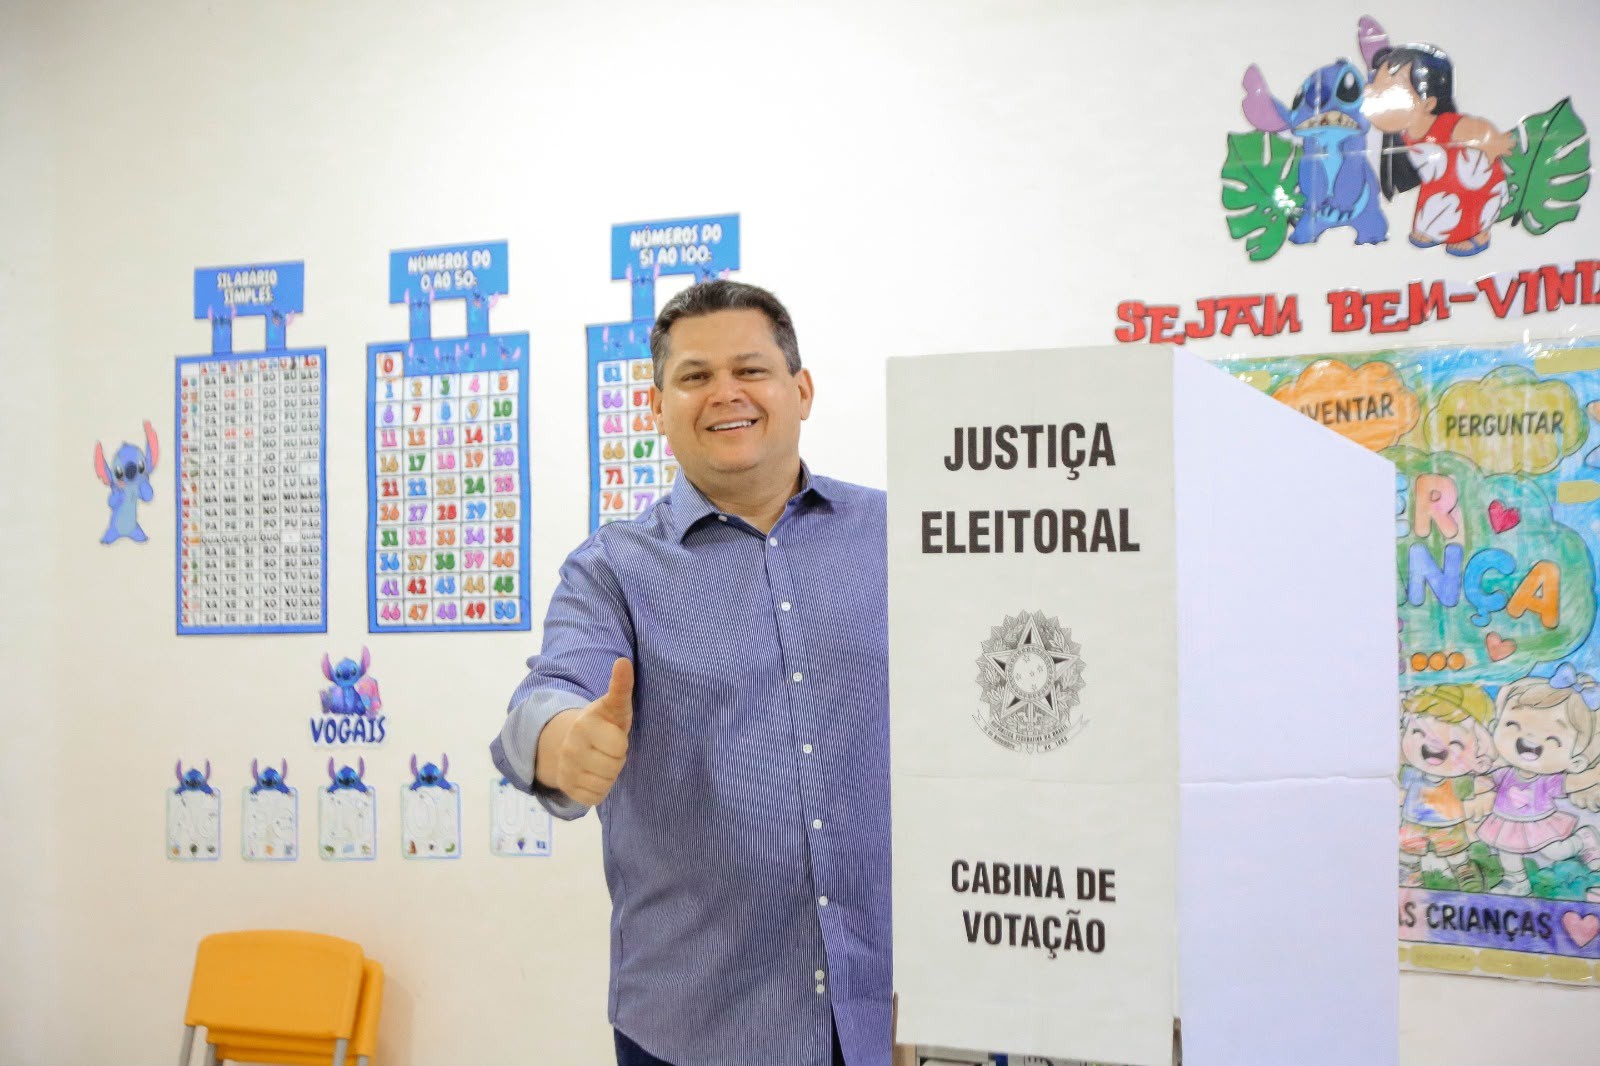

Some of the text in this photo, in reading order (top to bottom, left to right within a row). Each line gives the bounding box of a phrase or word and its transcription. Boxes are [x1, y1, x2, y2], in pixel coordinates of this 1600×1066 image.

[630, 224, 722, 248] NÚMEROS DO
[408, 250, 491, 272] NÚMEROS DO
[658, 246, 678, 265] AO
[216, 266, 278, 288] SILABÁRIO
[434, 271, 451, 290] AO
[1114, 293, 1303, 345] SEJAM
[383, 355, 394, 373] 0
[469, 375, 480, 392] 4
[498, 374, 509, 391] 5
[602, 389, 623, 409] 56
[412, 404, 422, 422] 7
[493, 400, 513, 417] 10
[603, 414, 623, 433] 61
[1445, 411, 1564, 437] PERGUNTAR
[381, 423, 512, 447] 11 12 13 14 15
[603, 439, 655, 460] 66 67
[944, 422, 1116, 481] JUSTIÇA
[380, 454, 399, 472] 16
[408, 454, 426, 471] 17
[465, 450, 484, 468] 19
[606, 466, 624, 485] 71
[633, 465, 655, 484] 72
[382, 479, 399, 497] 21
[408, 478, 427, 496] 22
[465, 476, 485, 494] 24
[380, 503, 399, 521] 26
[408, 504, 427, 521] 27
[466, 501, 486, 519] 29
[494, 501, 516, 518] 30
[603, 490, 624, 511] 76
[382, 527, 514, 546] 31 32 33 34 35
[921, 508, 1141, 554] ELEITORAL
[380, 550, 515, 571] 36 37 38 39 40
[263, 572, 276, 580] TO
[283, 571, 297, 580] TU
[381, 575, 514, 596] 41 42 43 44 45
[1397, 543, 1561, 629] NÇA
[263, 586, 276, 594] VO
[283, 585, 297, 594] VU
[381, 600, 517, 620] 46 47 48 49 50
[310, 716, 386, 743] VOGAIS
[951, 859, 1116, 902] CABINA DE
[1425, 903, 1551, 941] CRIANÇAS
[962, 908, 1106, 960] VOTAÇÃO
